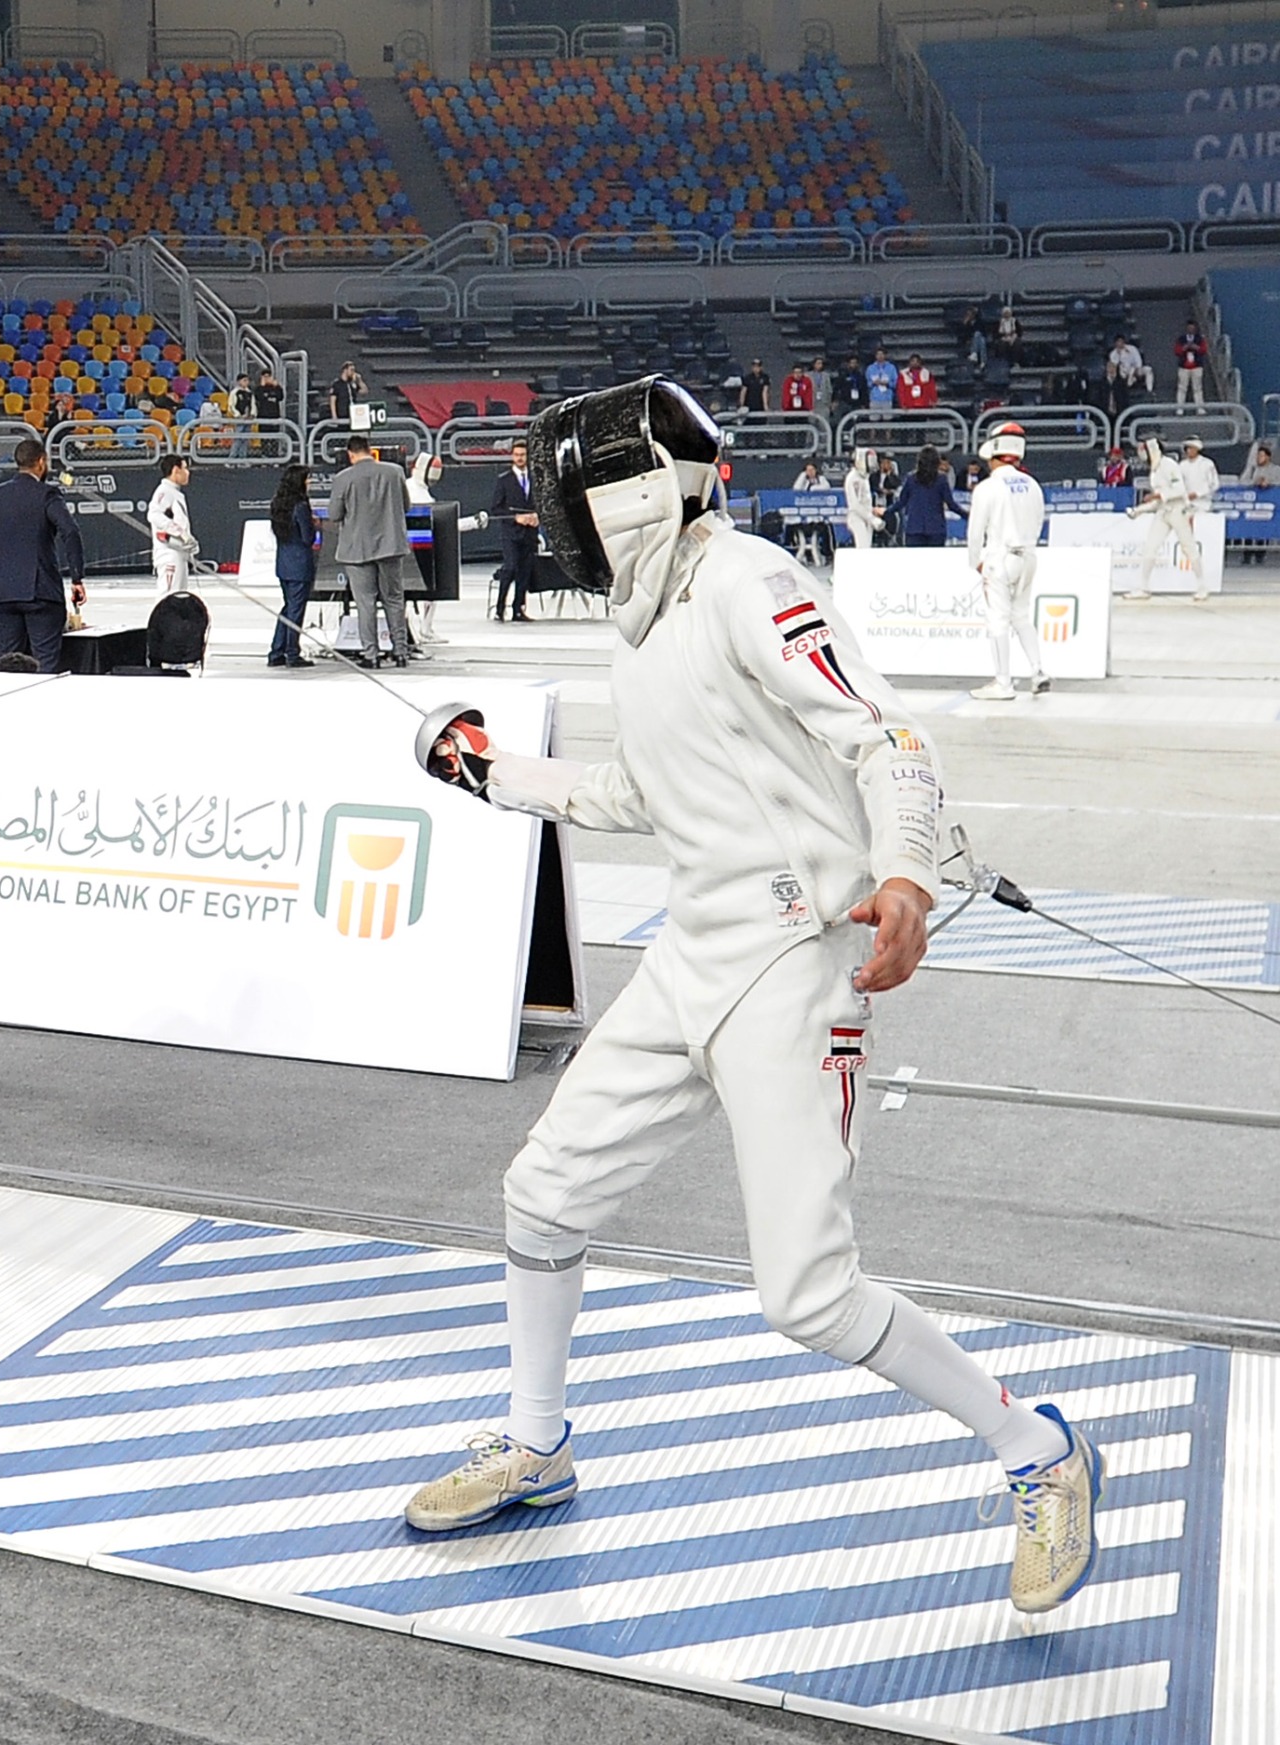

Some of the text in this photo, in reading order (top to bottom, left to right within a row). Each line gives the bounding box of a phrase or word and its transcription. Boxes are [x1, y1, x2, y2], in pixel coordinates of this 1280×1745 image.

[1197, 182, 1280, 220] CAI
[370, 408, 386, 424] 10
[867, 627, 924, 638] NATIONAL
[928, 627, 962, 639] BANK
[965, 628, 982, 639] OF
[75, 881, 150, 911] BANK
[158, 887, 196, 914] OF
[203, 891, 298, 924] EGYPT
